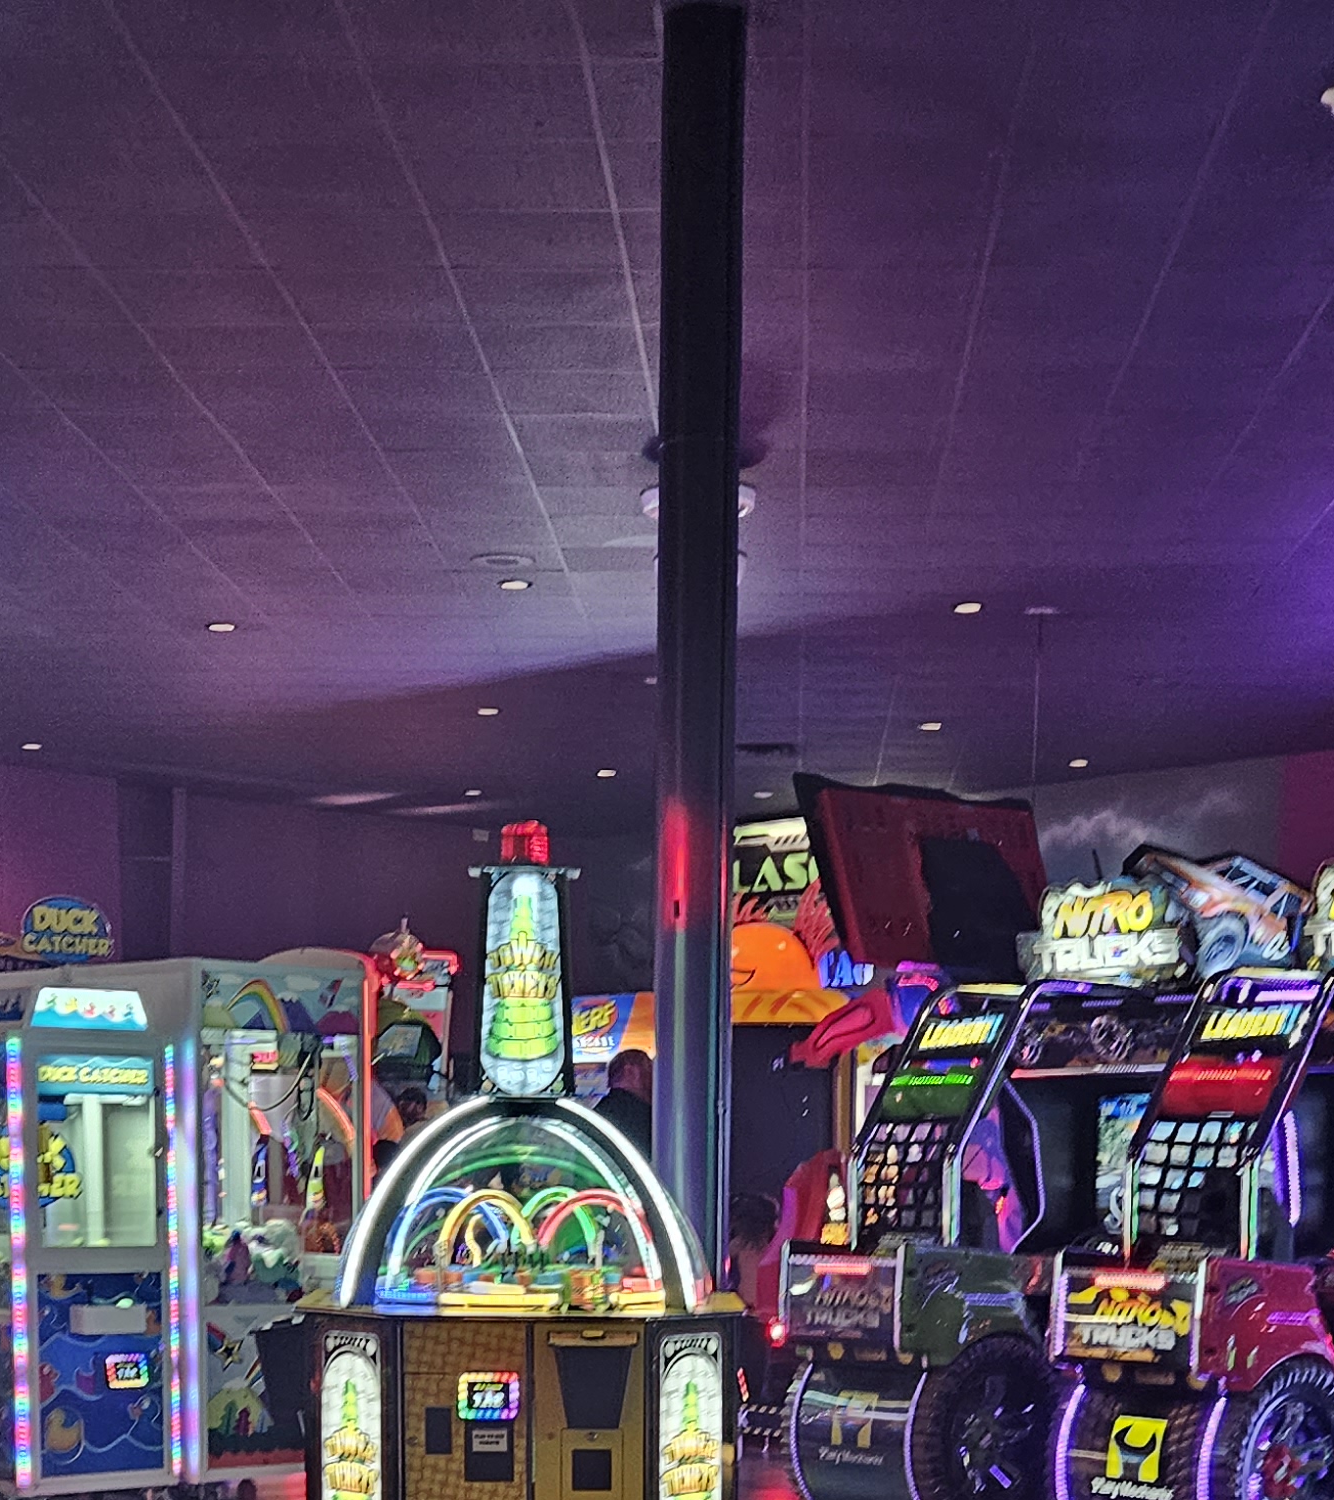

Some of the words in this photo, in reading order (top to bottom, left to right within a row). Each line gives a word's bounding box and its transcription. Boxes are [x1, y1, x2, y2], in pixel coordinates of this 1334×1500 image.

[32, 906, 99, 935] DUCK
[1053, 890, 1154, 939] NITRO
[22, 933, 114, 957] CATCHER
[1033, 927, 1180, 974] TRUCKS
[38, 1064, 77, 1083] DUCK
[1093, 1298, 1163, 1327] NITRO
[1078, 1322, 1176, 1351] TRUCKS
